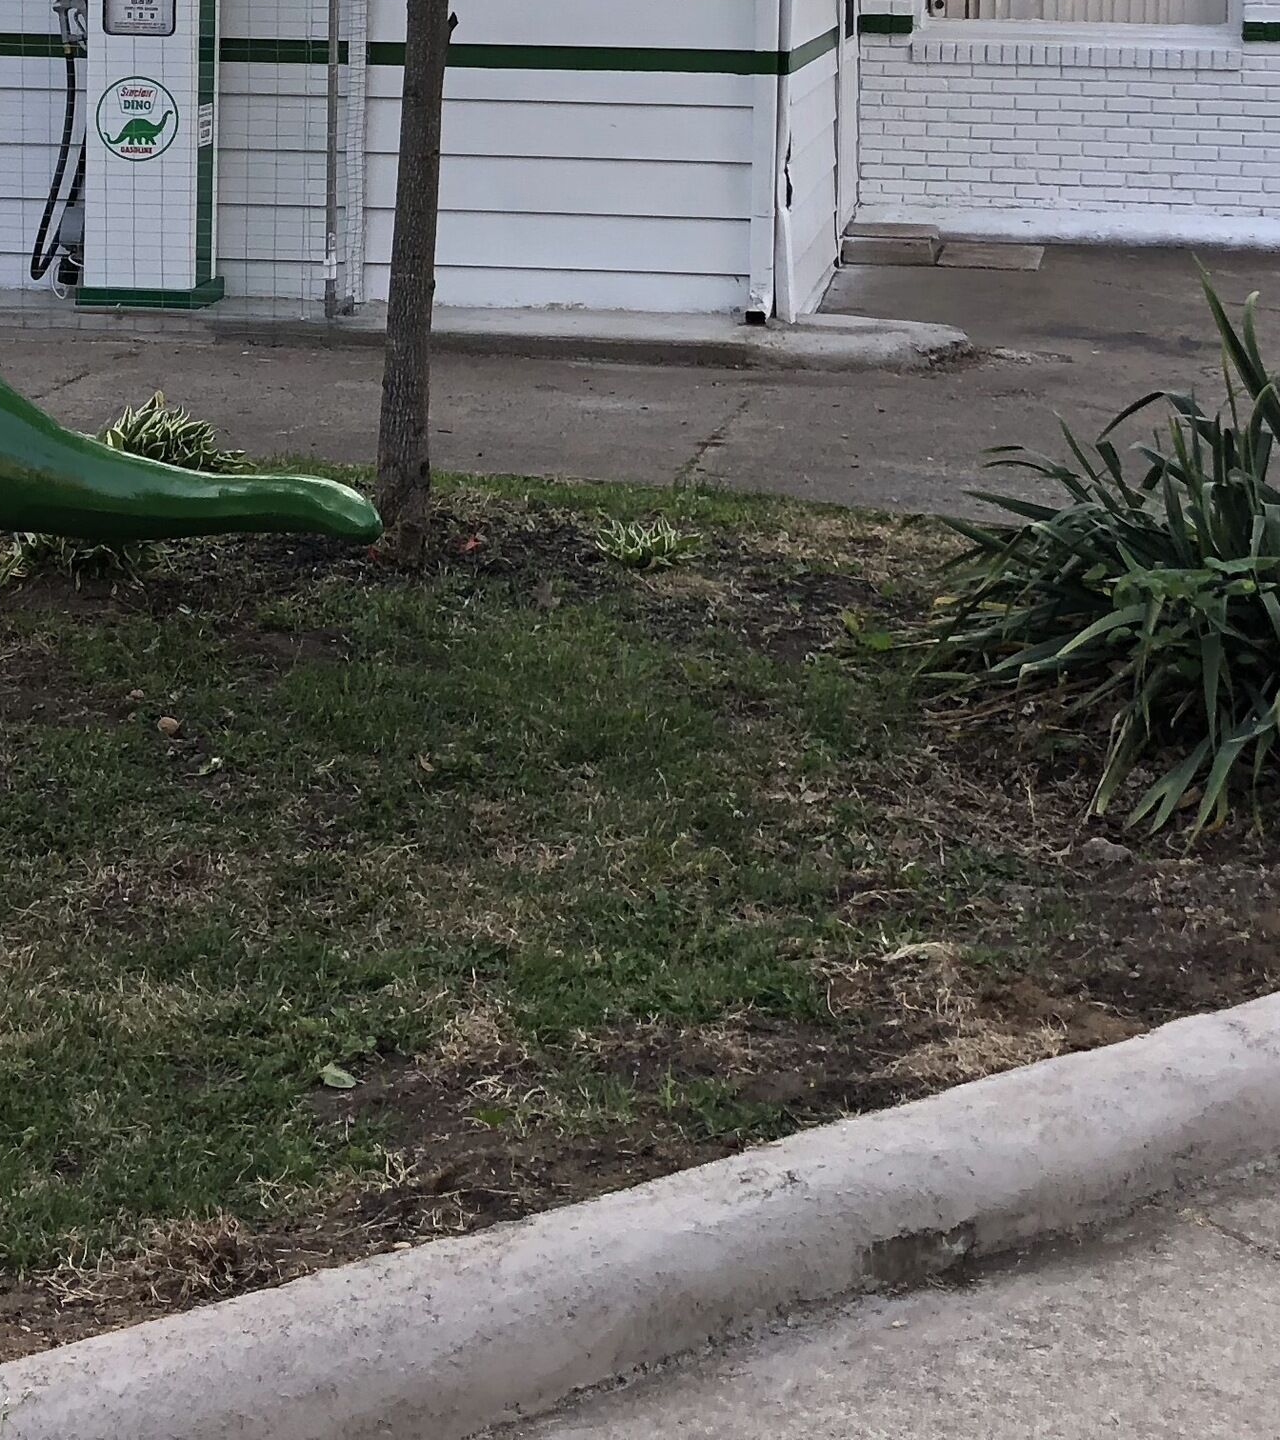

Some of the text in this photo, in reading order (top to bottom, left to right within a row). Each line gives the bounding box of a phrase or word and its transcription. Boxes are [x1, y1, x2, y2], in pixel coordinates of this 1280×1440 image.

[120, 86, 154, 98] Sinclair
[123, 100, 152, 110] DINO
[120, 146, 153, 154] GASOLINE
